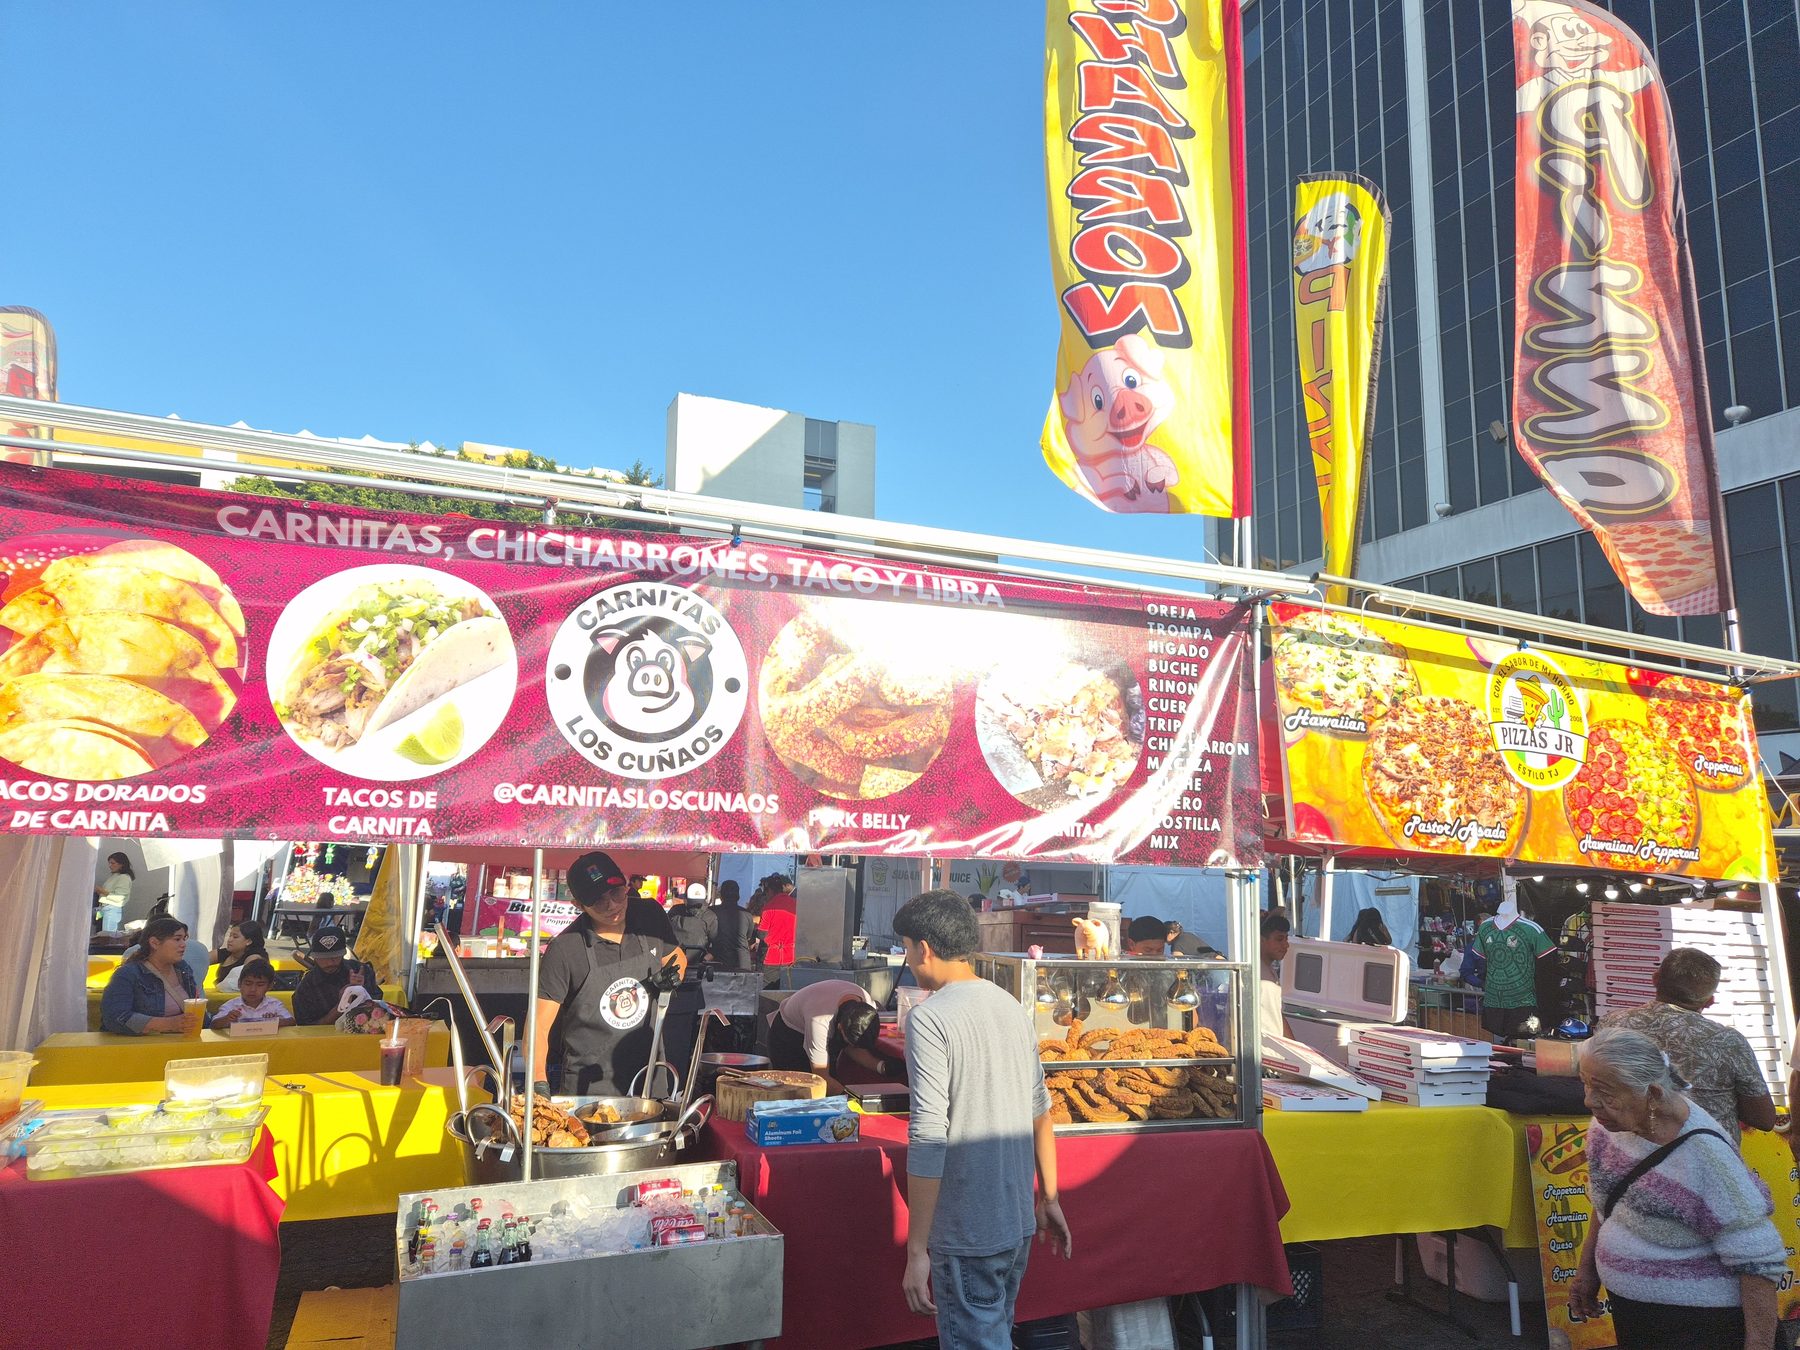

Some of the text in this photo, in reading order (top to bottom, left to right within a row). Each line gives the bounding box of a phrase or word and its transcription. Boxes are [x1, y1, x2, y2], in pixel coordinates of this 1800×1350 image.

[215, 504, 1005, 609] CARNITAS, CHICHARRONES, TACO Y LIBRA
[576, 588, 721, 636] CARNITAS
[1146, 602, 1197, 621] OREJA
[1146, 621, 1214, 642] TROMPA
[1147, 639, 1210, 660] HIGADO
[1147, 658, 1199, 678] BUCHE
[1147, 697, 1189, 715] CUER
[1147, 716, 1183, 733] TRIP
[1284, 709, 1368, 733] Hawaiian
[565, 714, 724, 774] LOS CUÑAOS
[1501, 726, 1574, 755] PIZZAS JR
[1517, 763, 1545, 780] ESTILO
[1694, 754, 1745, 777] Pepperoni
[0, 780, 207, 804] ACOS DORADOS
[323, 786, 438, 811] TACOS DE
[492, 782, 780, 815] @CARNITASLOSCUNAOS
[10, 810, 171, 832] DE CARNITA
[327, 813, 433, 838] CARNITA
[861, 812, 912, 831] BELLY
[1402, 815, 1508, 843] Pastor/Asada
[1149, 833, 1180, 851] MIX
[1578, 832, 1701, 863] Hawaiian/Pepperoni
[507, 900, 564, 915] Buble
[1543, 1184, 1586, 1201] Pepperoni
[1546, 1211, 1588, 1226] Hawaiian
[1549, 1239, 1573, 1253] Queso
[1552, 1265, 1577, 1283] Supre
